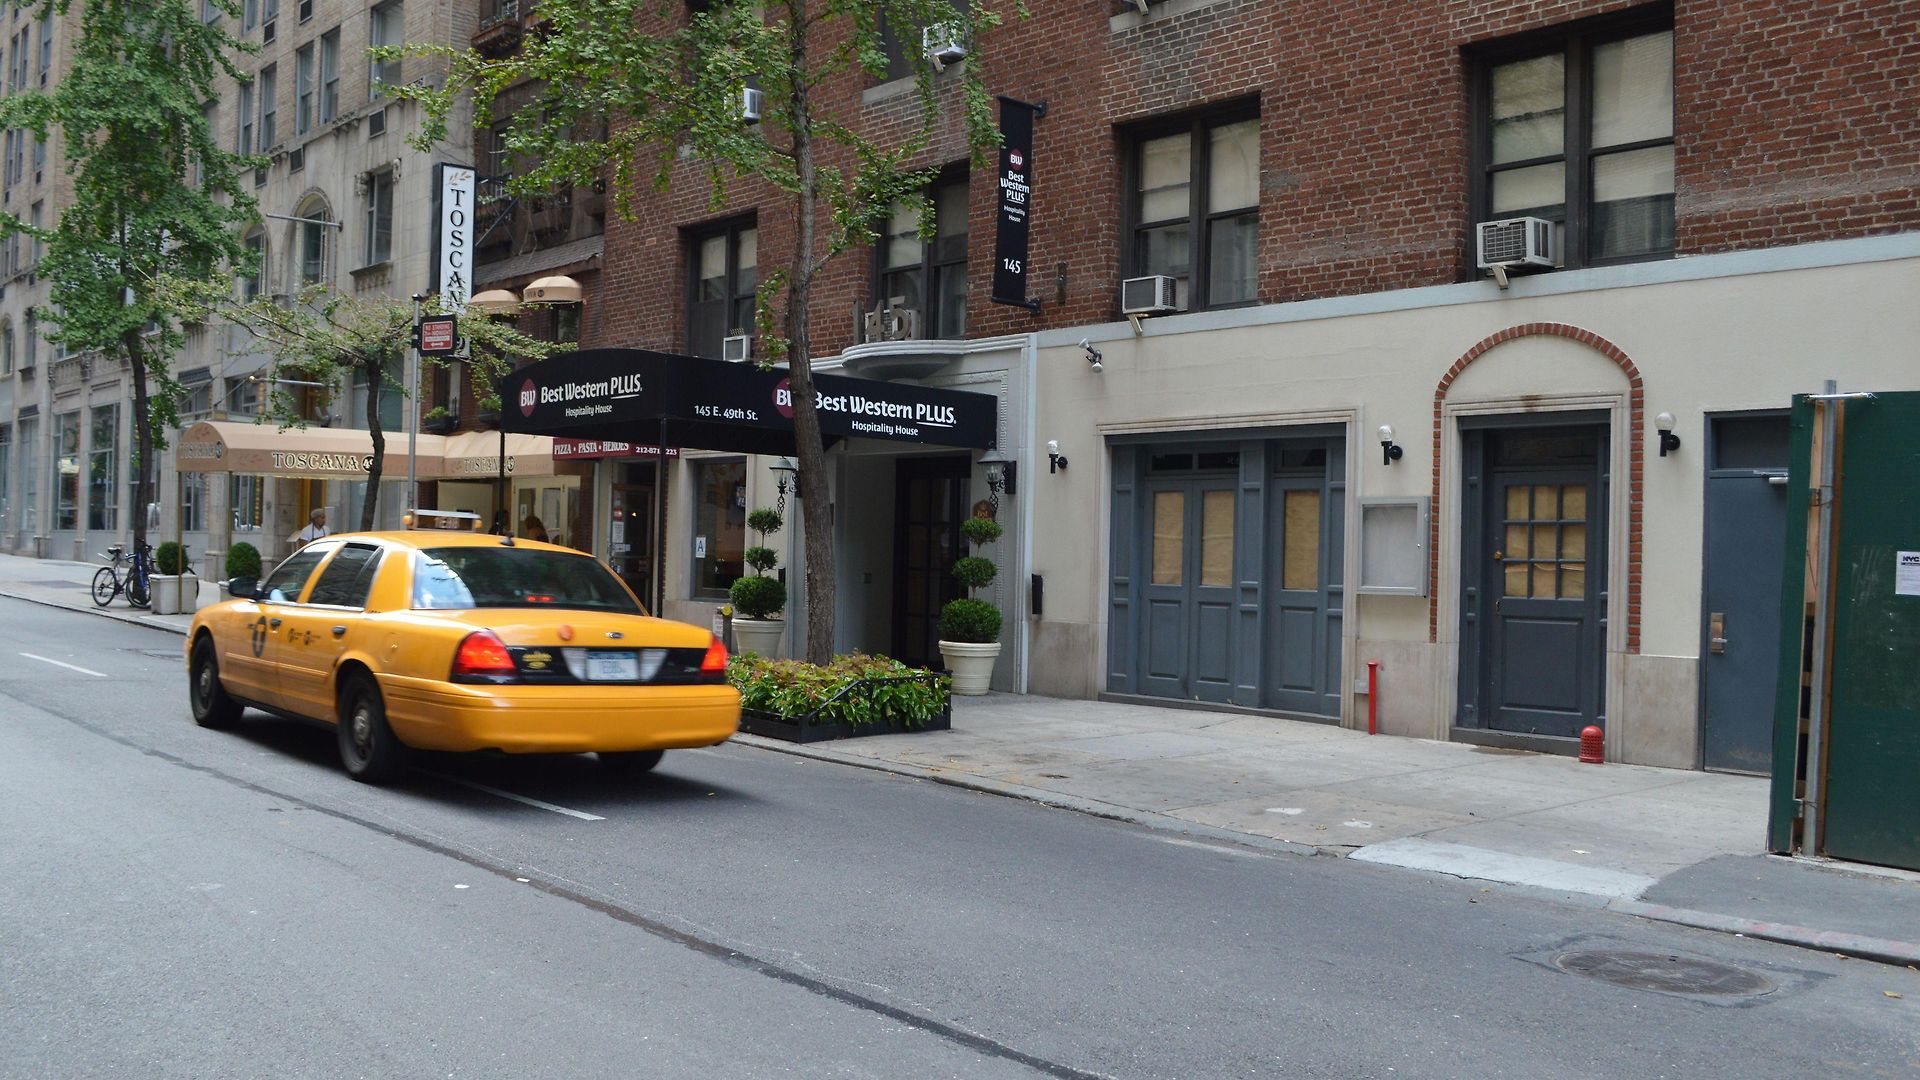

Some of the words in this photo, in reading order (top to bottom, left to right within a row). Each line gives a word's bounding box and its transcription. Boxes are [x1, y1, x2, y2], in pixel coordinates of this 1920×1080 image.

[1010, 154, 1022, 166] BW
[1008, 170, 1024, 183] Best
[1000, 177, 1030, 194] Western
[1006, 188, 1025, 203] PLUS
[1003, 204, 1026, 217] Hospitality
[1008, 213, 1021, 223] House
[1003, 257, 1021, 274] 145
[853, 295, 912, 343] 145
[520, 390, 536, 407] BW
[540, 386, 564, 404] Best
[564, 381, 609, 401] Western
[610, 373, 642, 396] PLUS
[565, 406, 595, 418] Hospitality
[594, 404, 613, 414] House
[694, 405, 711, 417] 145
[712, 406, 722, 417] E.
[723, 408, 745, 419] 49th
[746, 410, 759, 421] St.
[849, 395, 913, 420] Western
[915, 403, 956, 425] PLUS
[851, 420, 894, 436] Hospitality
[895, 425, 919, 436] House
[554, 443, 572, 455] PIZZA
[578, 442, 598, 454] PASTA
[272, 451, 360, 472] TOSCANA
[697, 540, 704, 553] A
